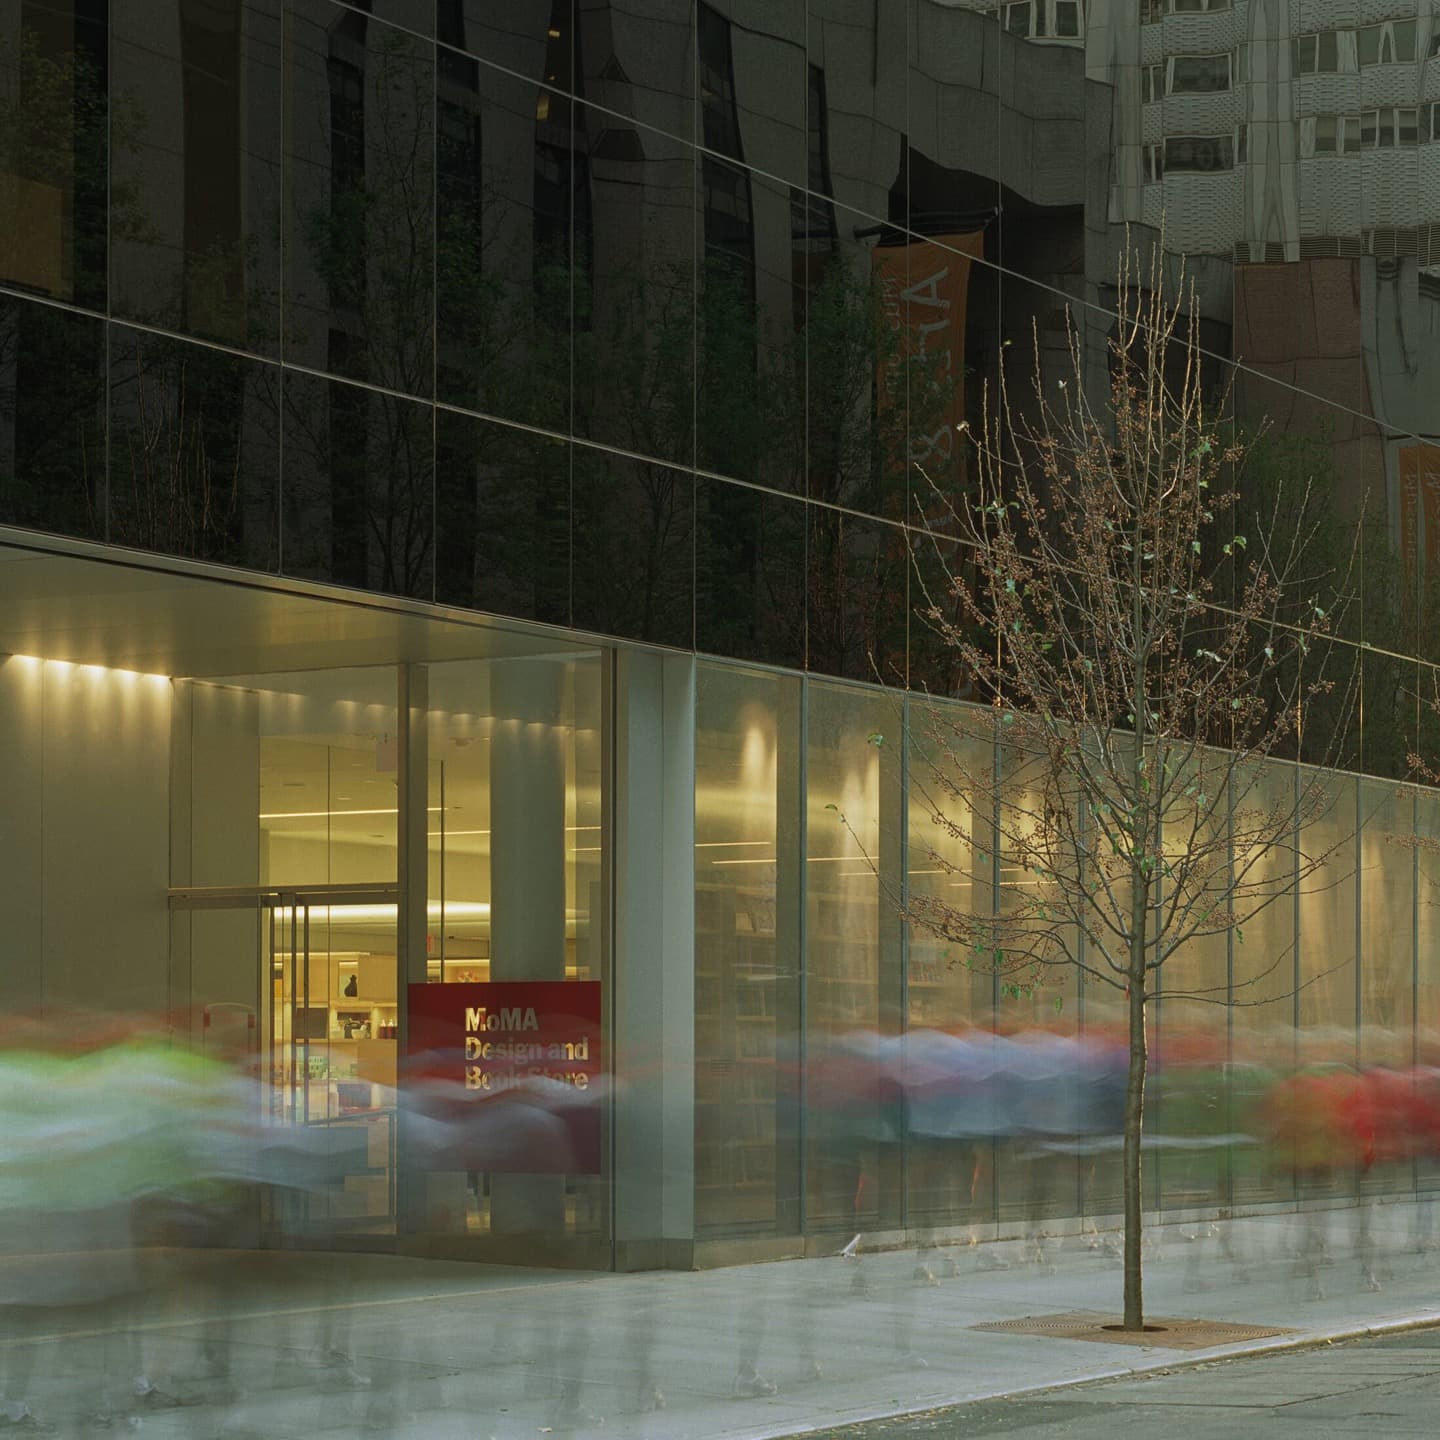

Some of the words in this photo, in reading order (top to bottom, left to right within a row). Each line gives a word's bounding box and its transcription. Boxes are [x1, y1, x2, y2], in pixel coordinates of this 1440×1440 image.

[465, 1007, 539, 1032] MoMA
[465, 1036, 542, 1065] Design
[548, 1036, 588, 1060] and
[465, 1066, 521, 1090] Book
